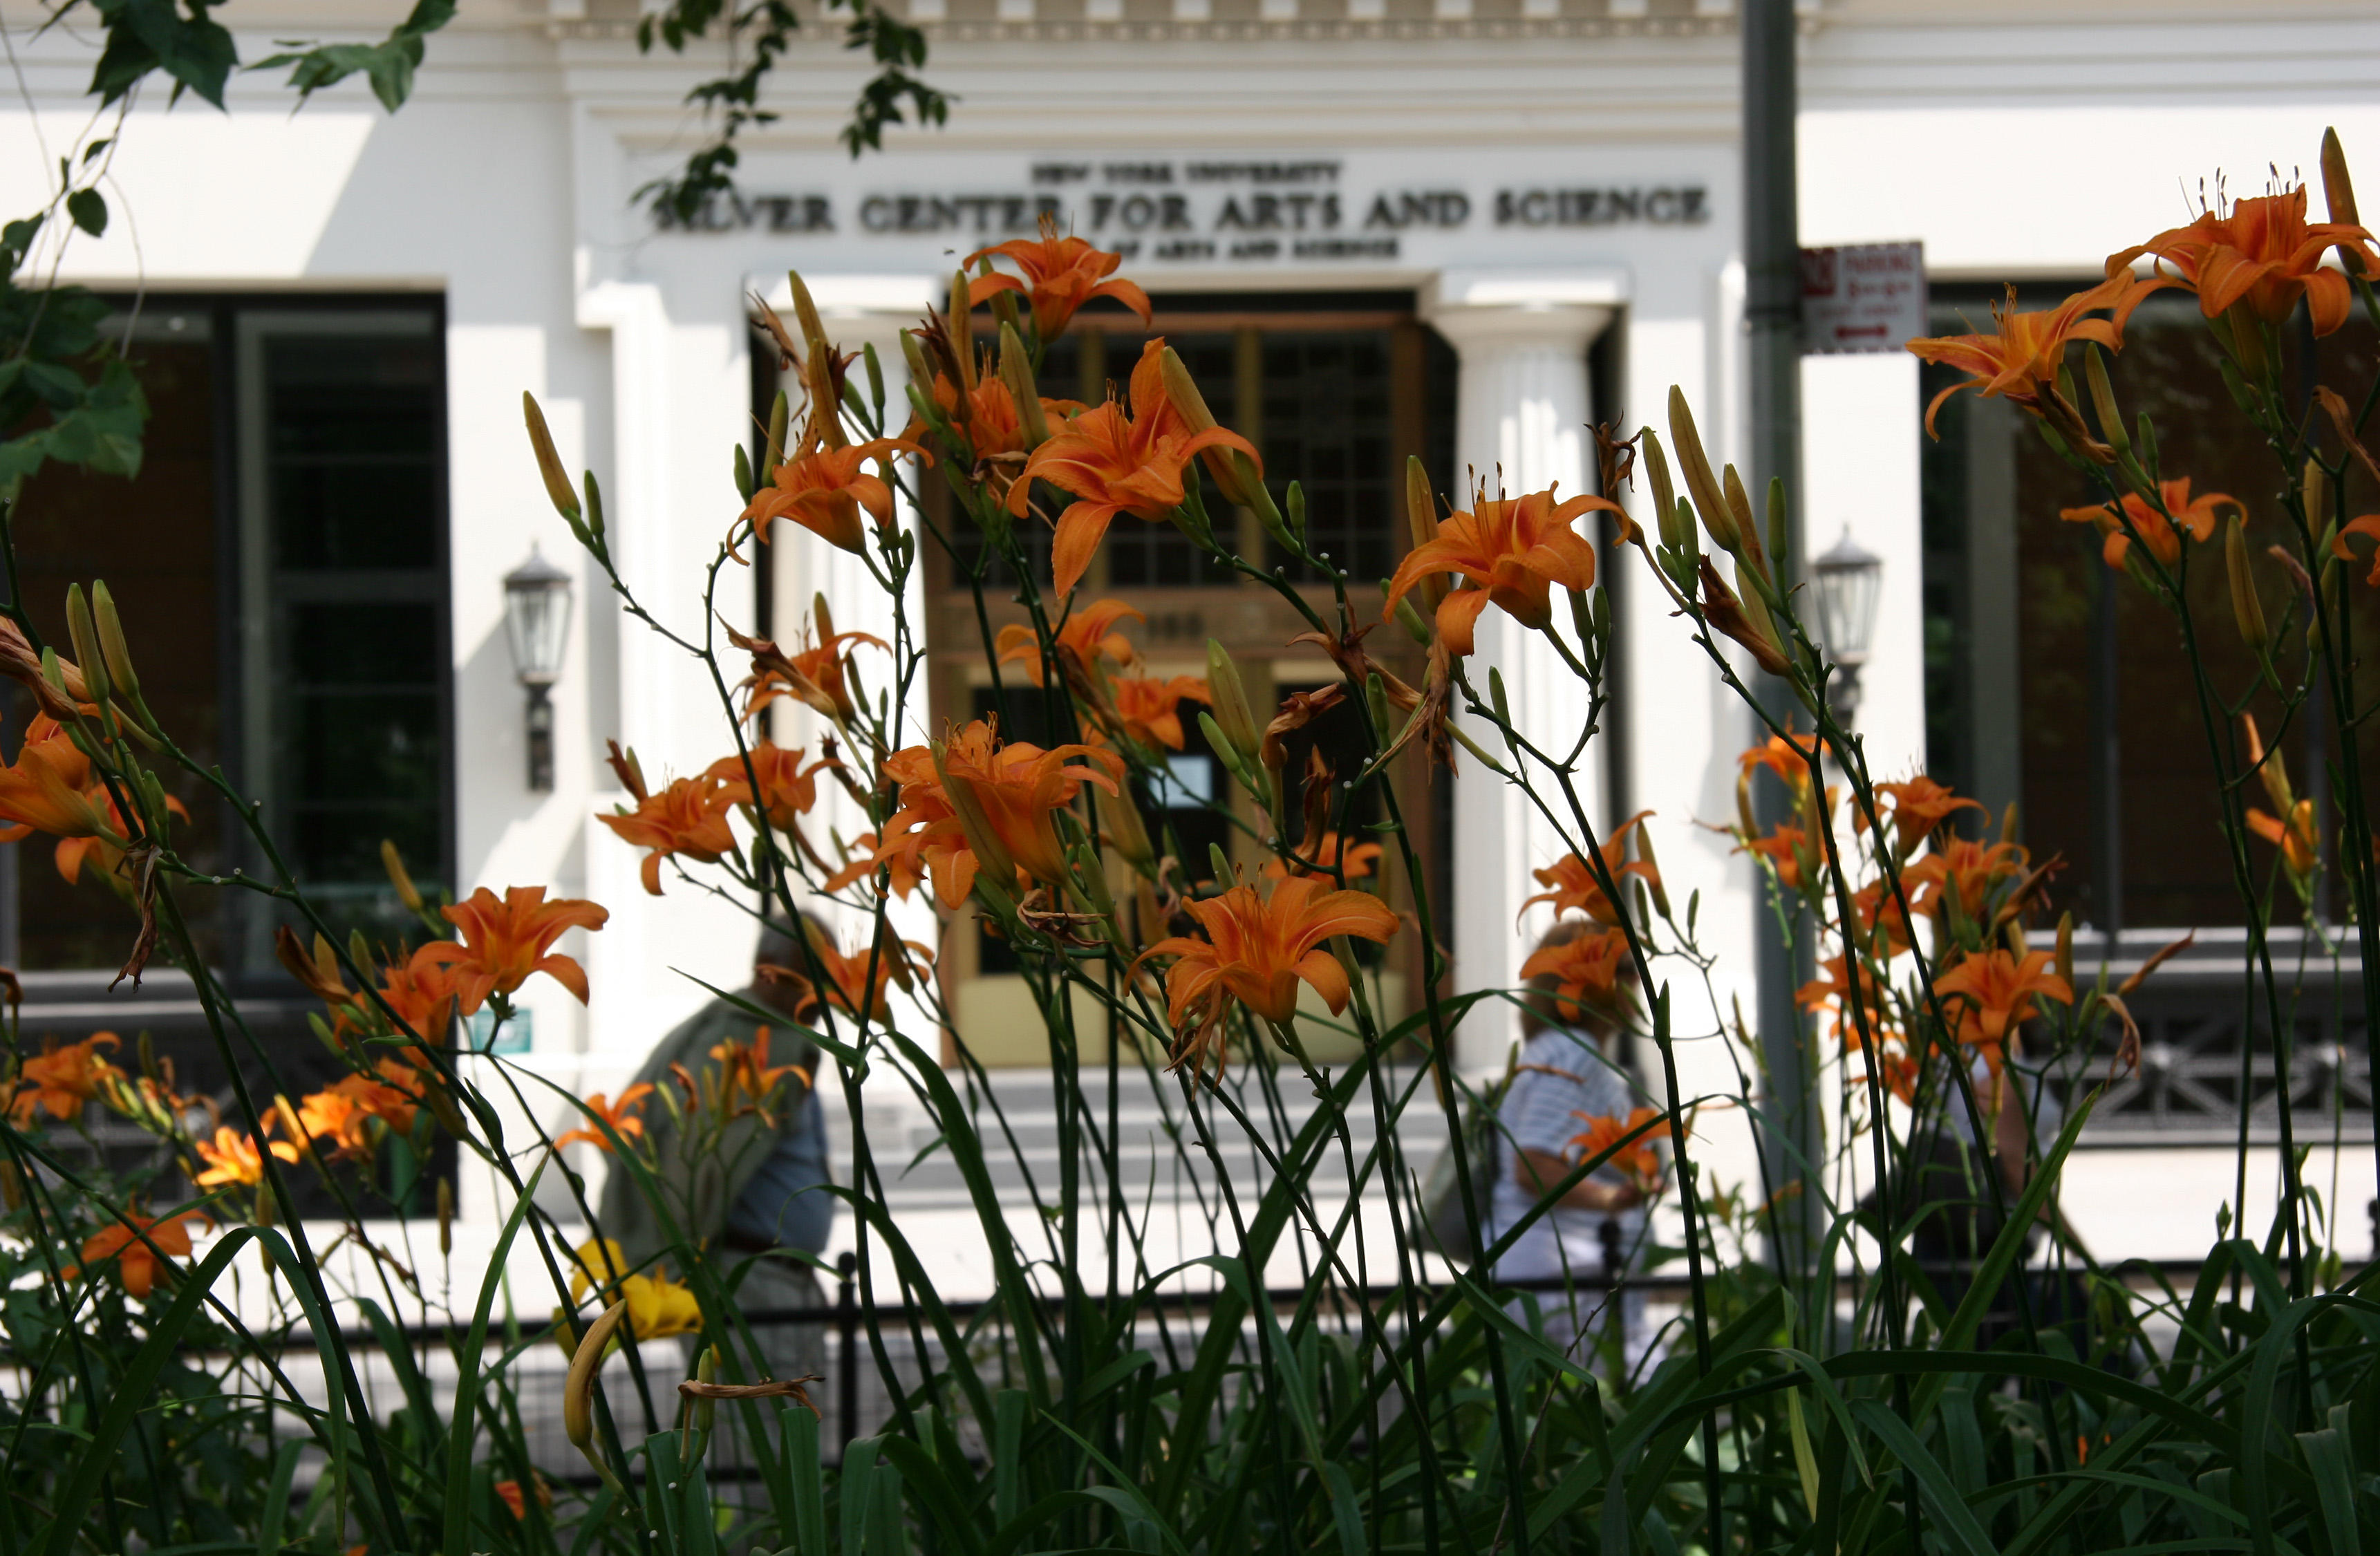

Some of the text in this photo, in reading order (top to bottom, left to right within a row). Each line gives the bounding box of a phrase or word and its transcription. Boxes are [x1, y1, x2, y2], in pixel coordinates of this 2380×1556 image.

[1032, 162, 1341, 182] NEW YORK UNIVERSITY
[860, 195, 1065, 232] CENTER
[1092, 194, 1191, 231] FOR
[1215, 194, 1341, 231] ARTS
[1364, 190, 1470, 229] AND
[1495, 187, 1709, 227] SCIENCE
